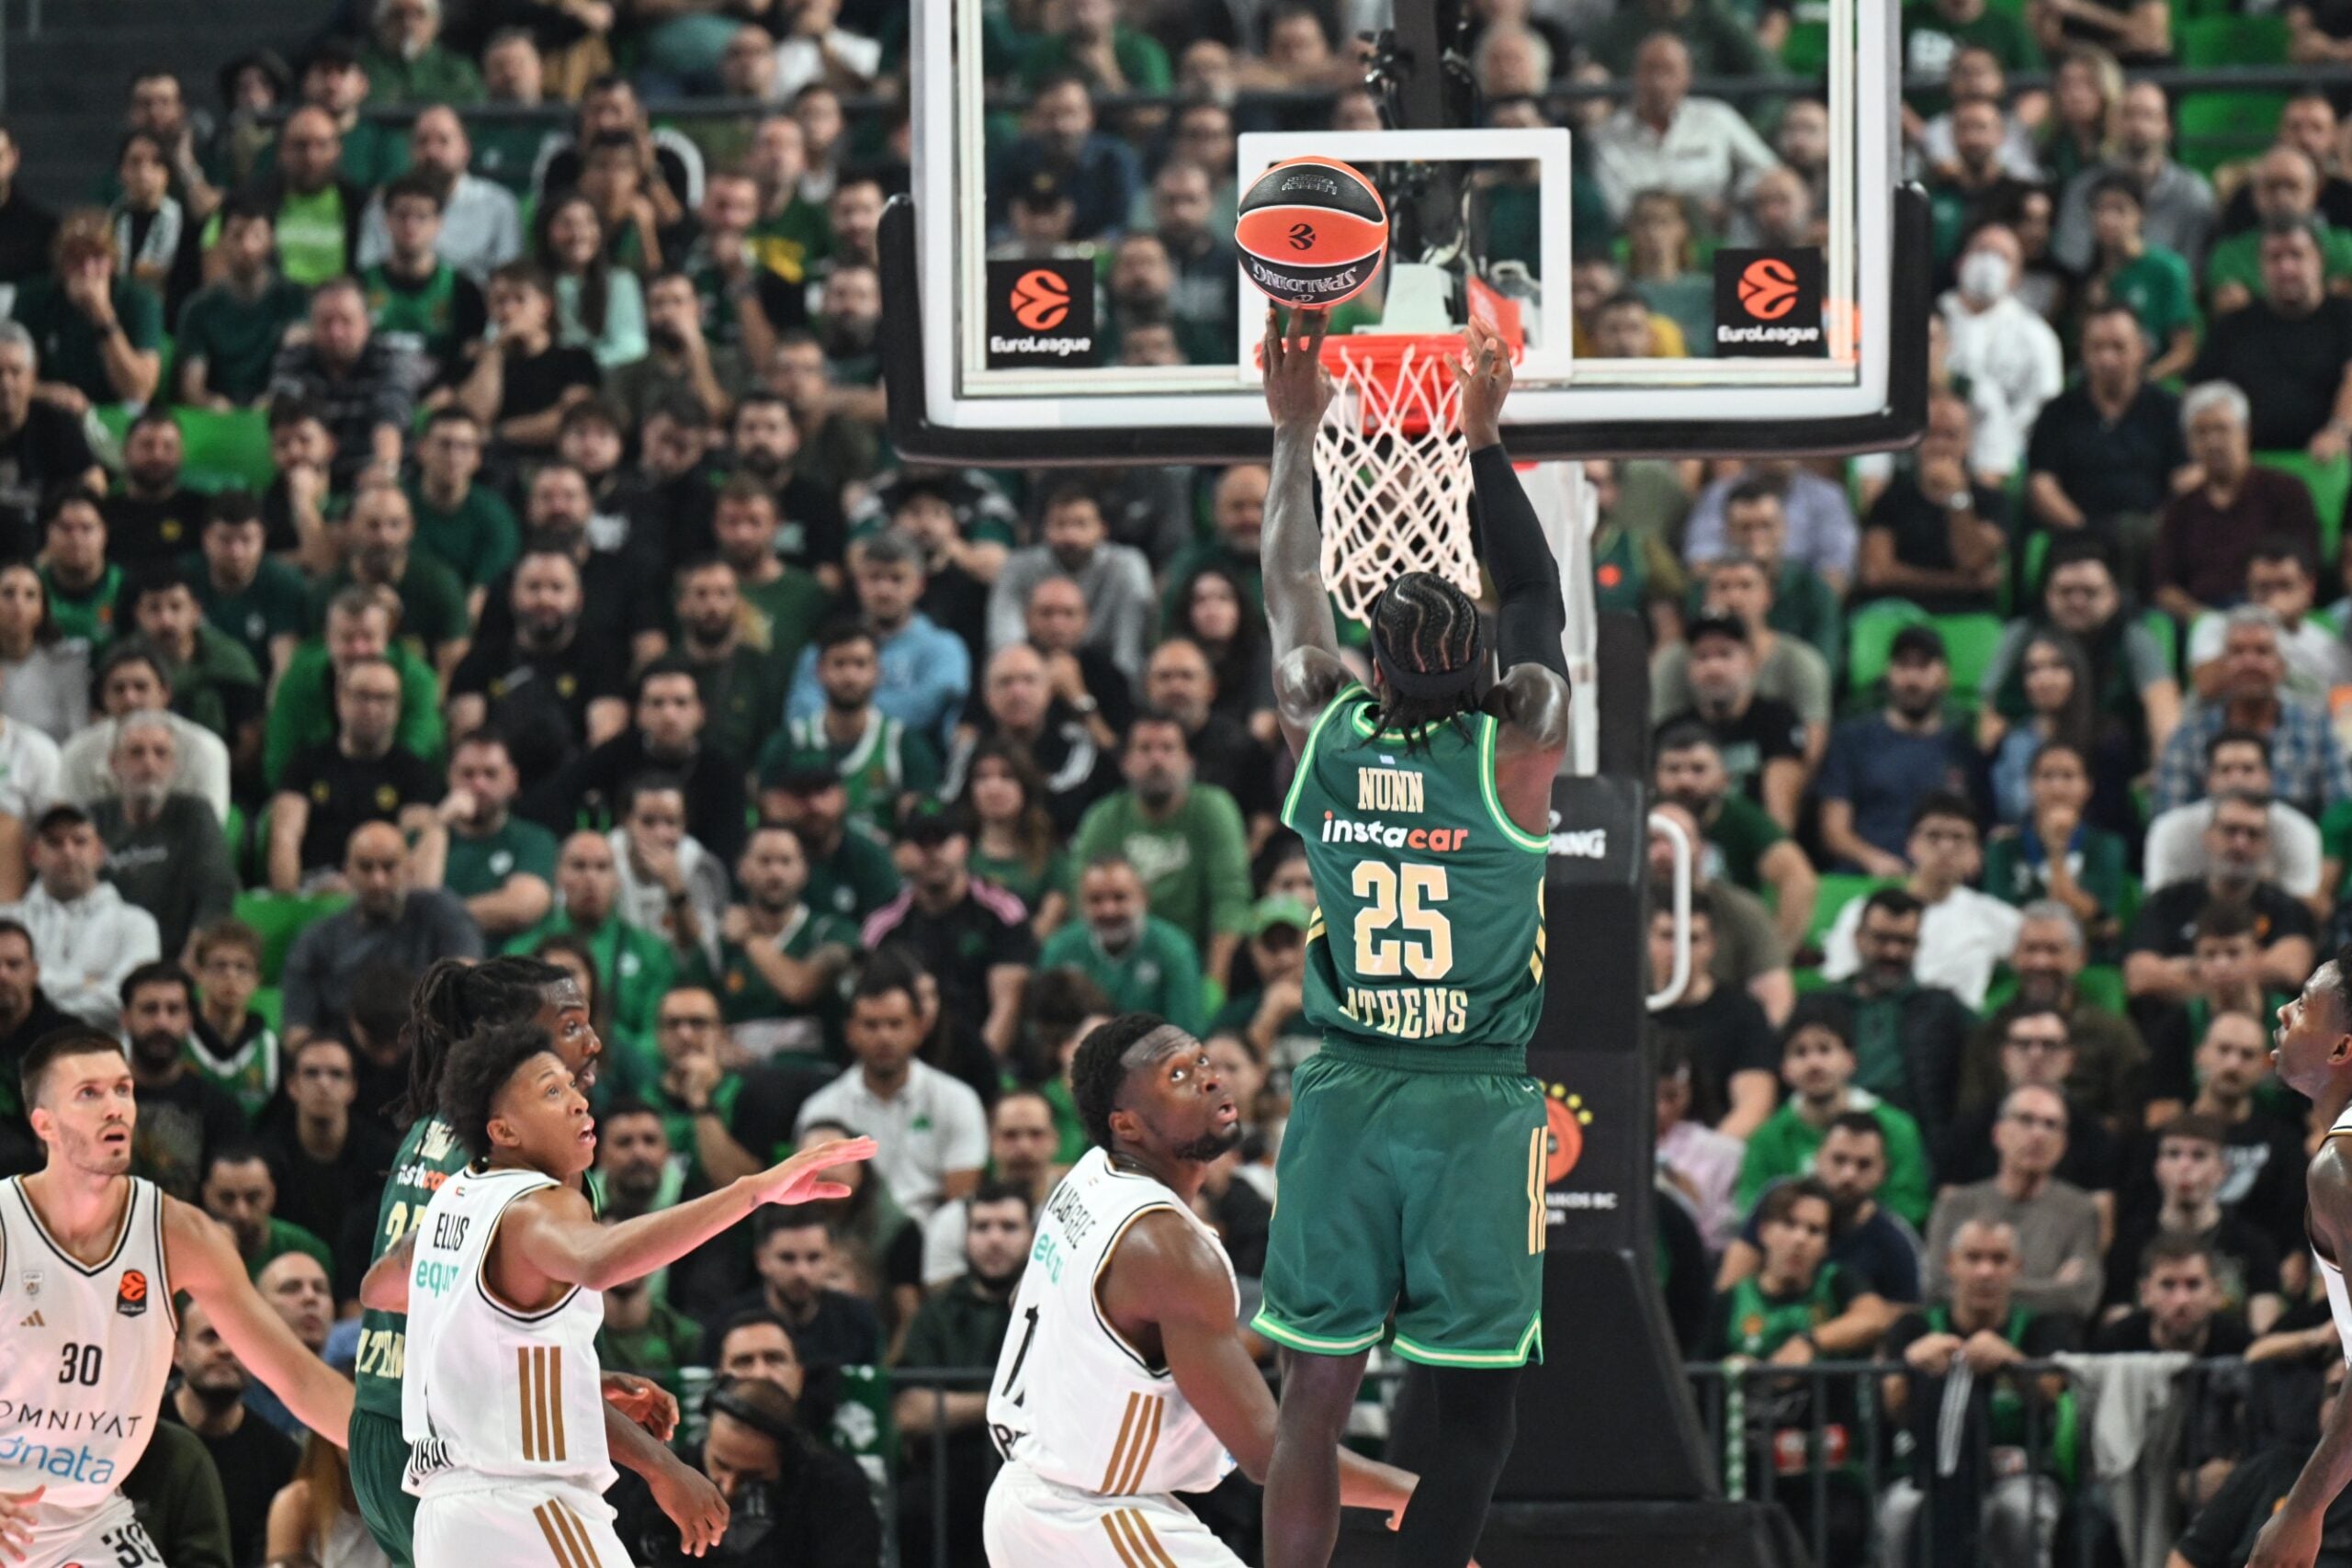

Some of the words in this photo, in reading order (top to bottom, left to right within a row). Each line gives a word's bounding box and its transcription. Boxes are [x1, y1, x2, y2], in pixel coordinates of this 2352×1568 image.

[1250, 256, 1357, 293] SPALDING
[990, 335, 1091, 356] EuroLeague
[1716, 324, 1819, 346] EuroLeague
[1357, 766, 1424, 814] NUNN
[1321, 809, 1469, 852] instacar
[1351, 860, 1453, 980] 25
[1338, 986, 1469, 1039] ATHENS
[433, 1212, 471, 1252] ELLIS
[58, 1342, 103, 1387] 30
